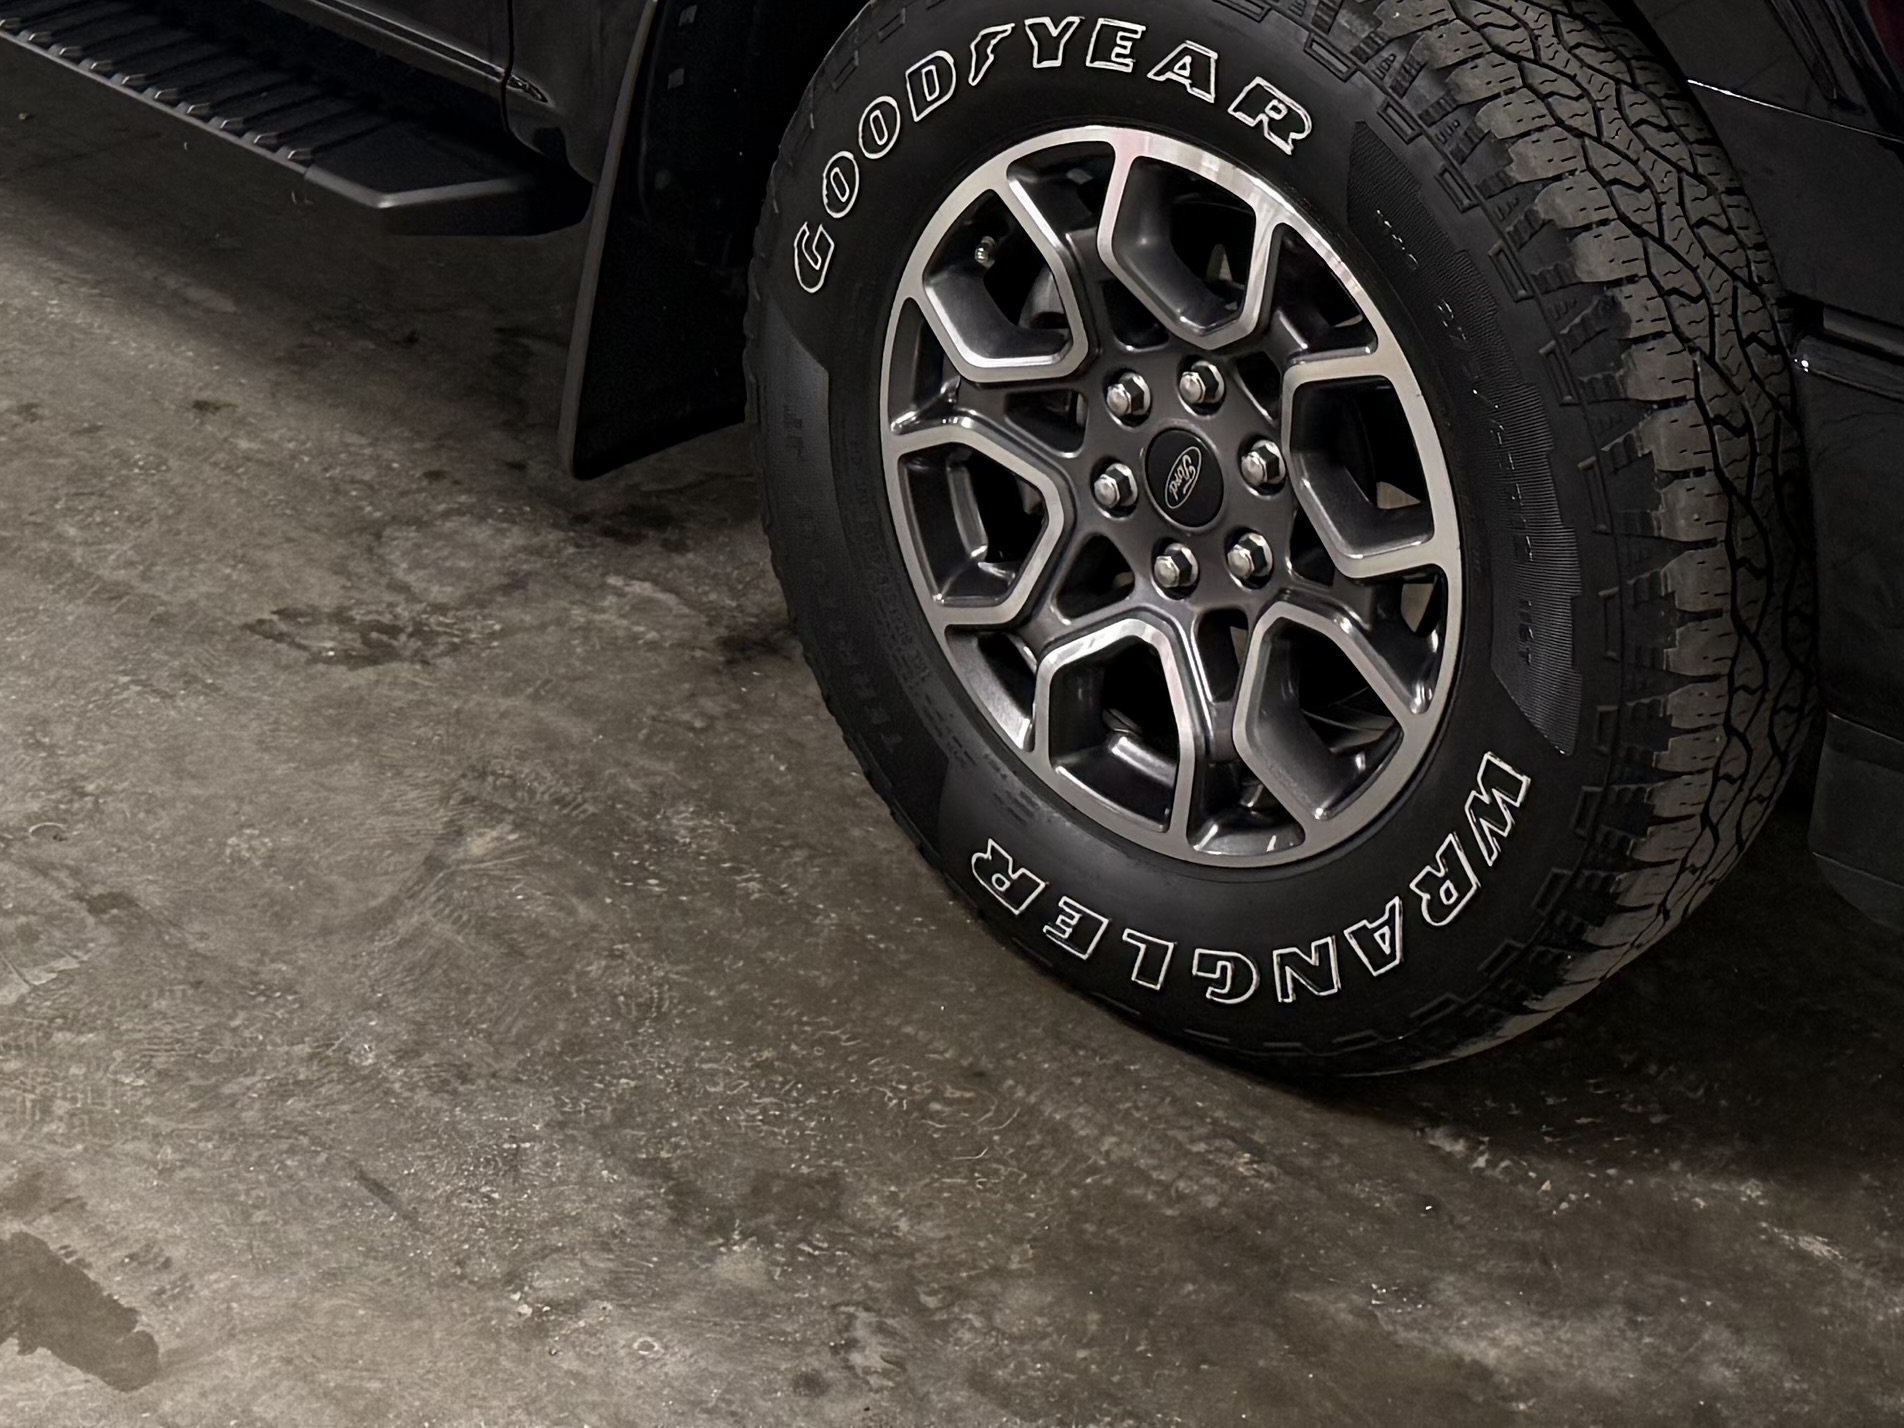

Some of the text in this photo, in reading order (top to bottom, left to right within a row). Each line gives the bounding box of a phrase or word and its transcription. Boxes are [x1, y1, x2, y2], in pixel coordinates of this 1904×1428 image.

[793, 16, 1315, 296] GOODYEAR
[1168, 453, 1197, 502] Ford
[969, 750, 1534, 1006] WRANGLER
